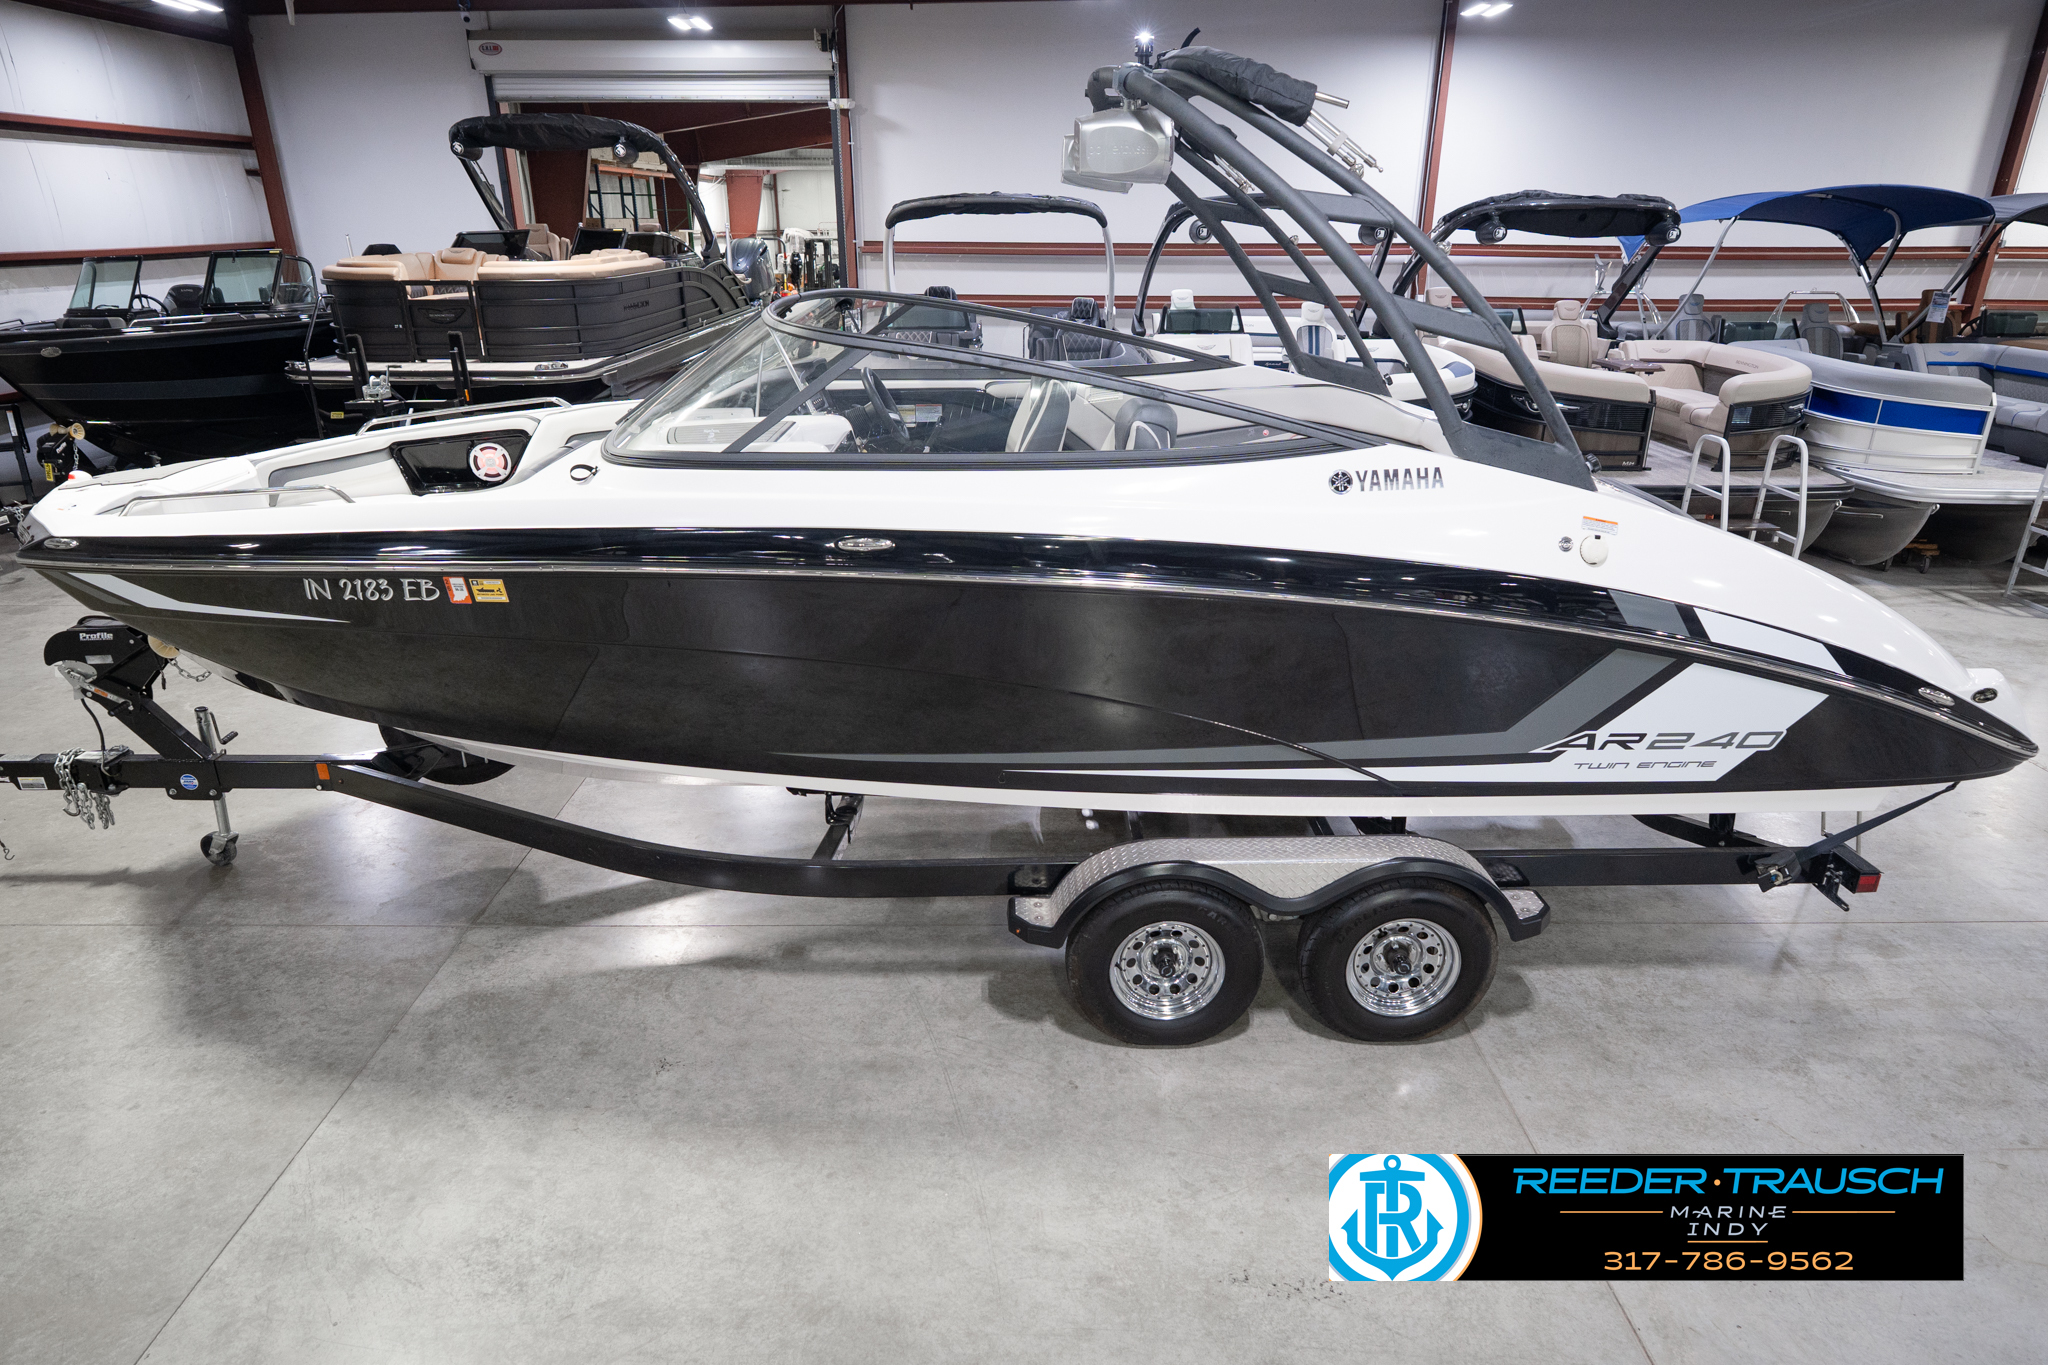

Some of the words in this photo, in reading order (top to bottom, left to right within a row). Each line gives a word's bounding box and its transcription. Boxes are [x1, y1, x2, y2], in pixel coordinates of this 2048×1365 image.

[1355, 467, 1445, 492] YAMAHA
[303, 577, 333, 600] IN
[338, 578, 394, 601] 2183
[400, 577, 441, 601] EB
[79, 631, 114, 640] Profile
[1542, 730, 1785, 751] AR240
[1573, 762, 1631, 770] TWIN
[1636, 760, 1718, 769] ENGINE
